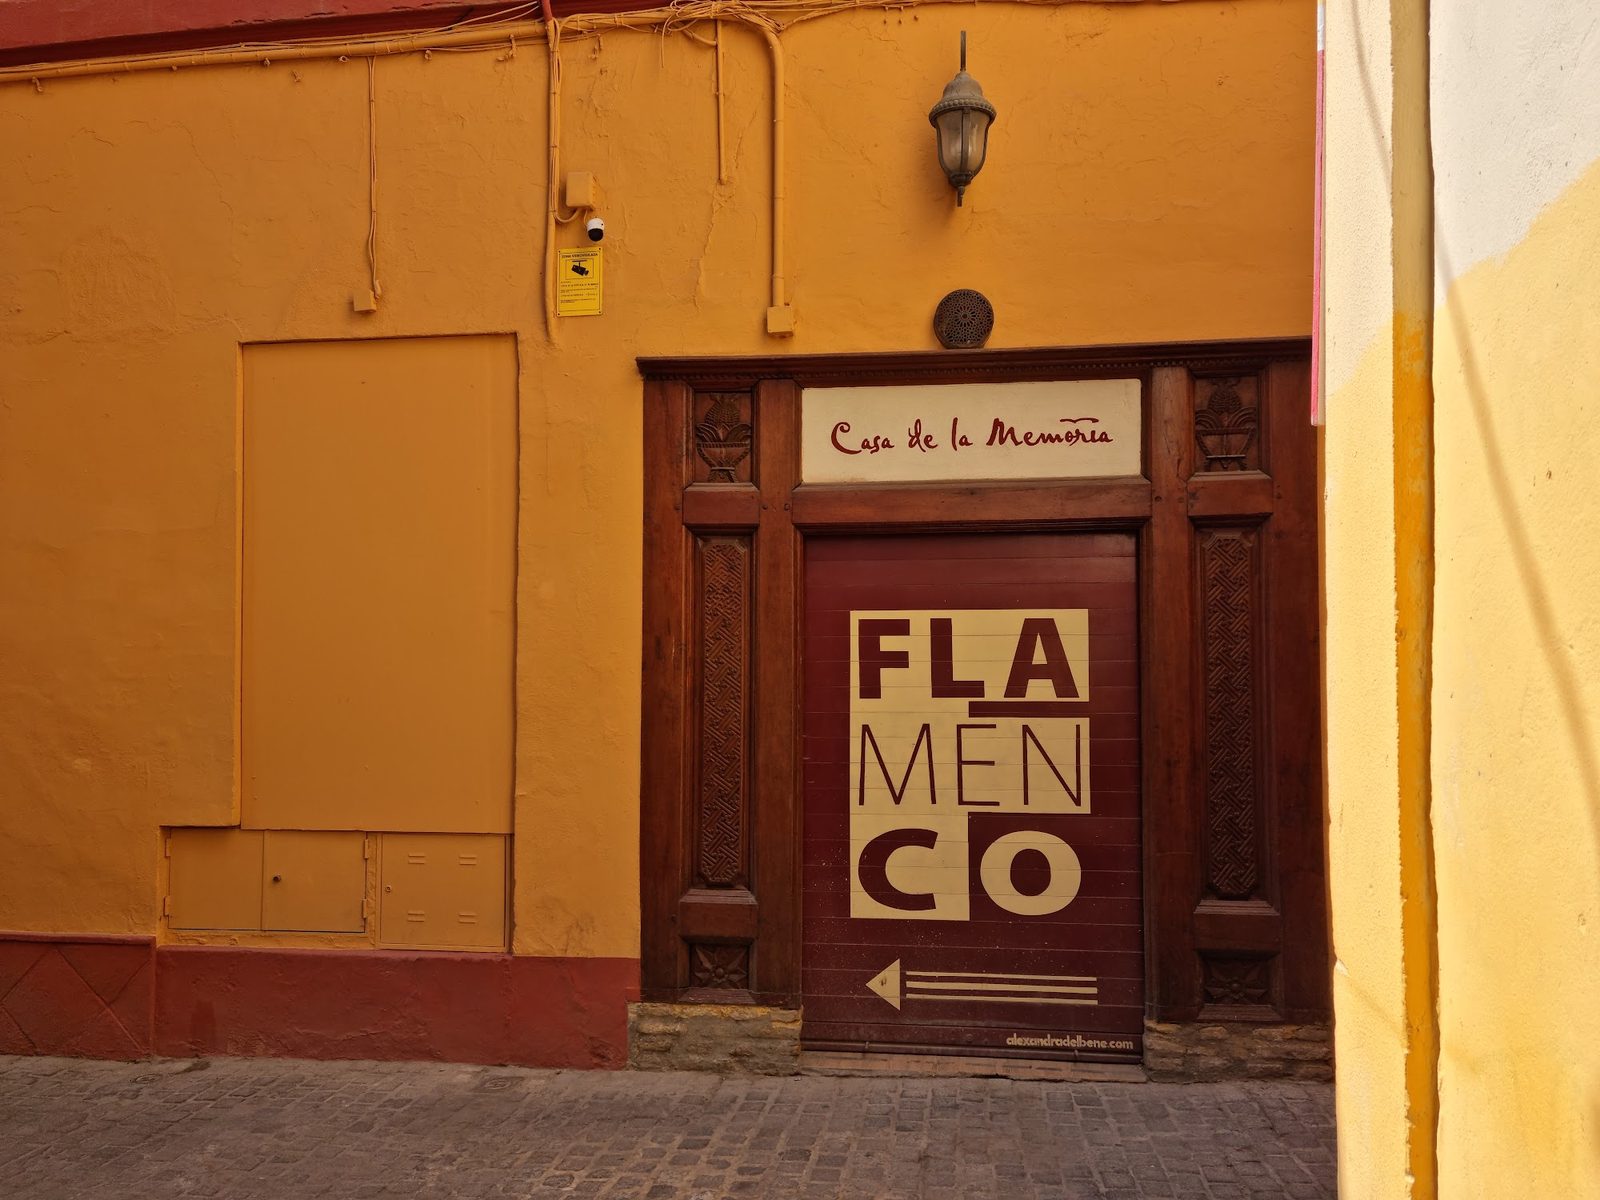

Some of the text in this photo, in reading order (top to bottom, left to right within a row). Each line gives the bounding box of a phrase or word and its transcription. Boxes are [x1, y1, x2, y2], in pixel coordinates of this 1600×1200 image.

[831, 421, 895, 455] Casa
[908, 418, 938, 452] de
[952, 417, 973, 451] la
[858, 617, 1080, 699] FLA
[858, 723, 1082, 807] MEN
[858, 828, 1082, 916] CO
[1006, 1033, 1134, 1050] alexandradelbene.com
